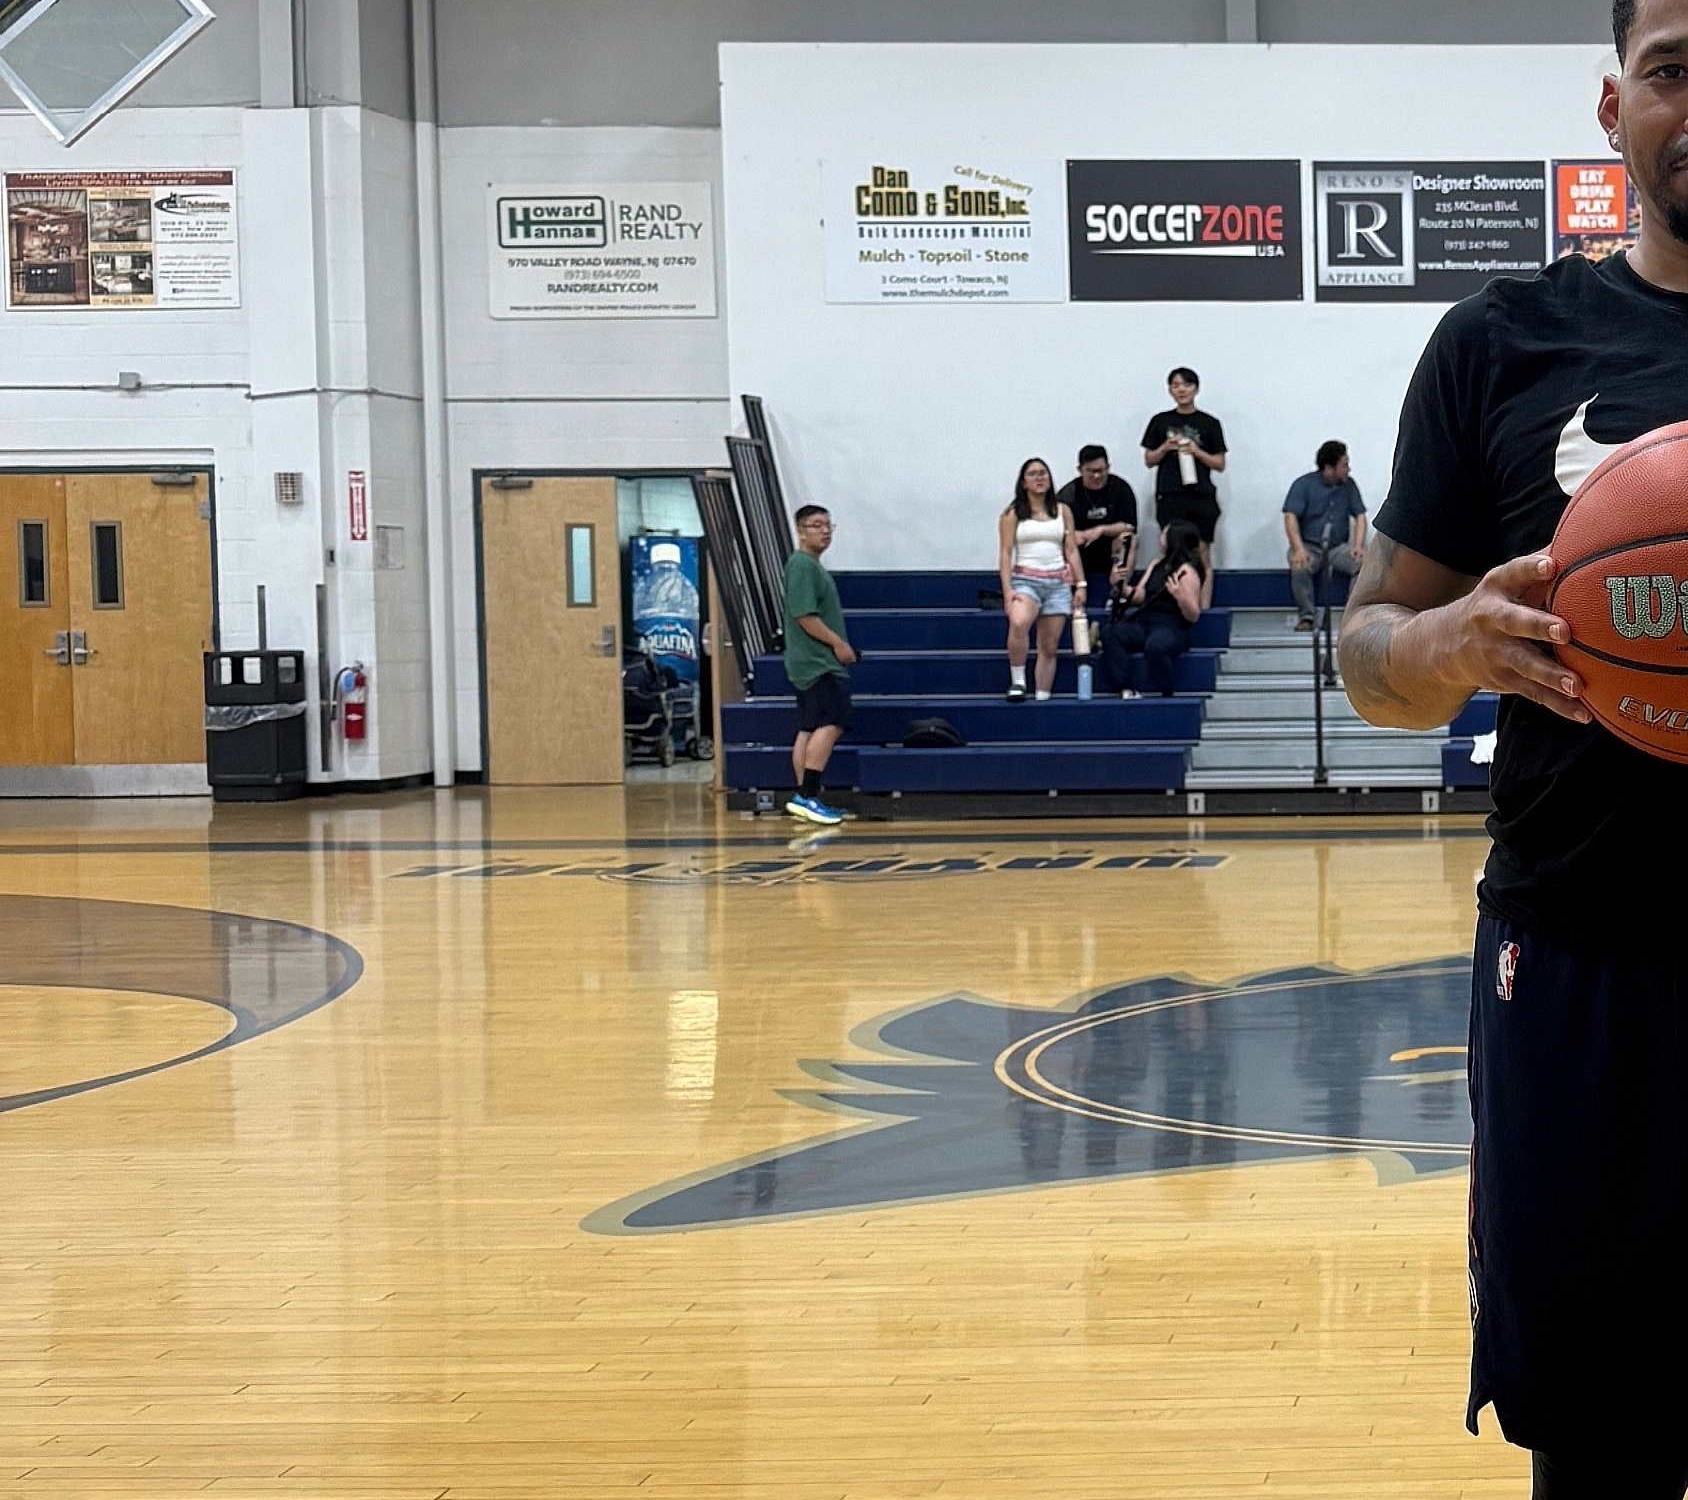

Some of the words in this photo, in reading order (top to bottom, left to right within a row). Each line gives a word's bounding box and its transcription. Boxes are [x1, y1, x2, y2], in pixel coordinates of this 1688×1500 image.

[873, 165, 908, 188] Dan
[954, 165, 973, 178] Call
[975, 170, 990, 182] for
[991, 175, 1034, 196] Delivery
[1412, 174, 1471, 194] Designer
[1473, 174, 1544, 190] Showroom
[1578, 169, 1607, 184] EAT
[1569, 184, 1615, 199] DRINK
[856, 185, 917, 216] Como
[925, 192, 937, 216] &
[944, 185, 1006, 218] Sons,
[1574, 199, 1612, 213] PLAY
[508, 203, 596, 222] Howard
[619, 205, 683, 221] RAND
[1336, 200, 1396, 258] R
[1419, 217, 1449, 229] Route
[1465, 217, 1475, 228] N
[1567, 214, 1619, 229] WATCH
[620, 223, 703, 240] REALTY
[859, 227, 888, 238] Bulk
[894, 227, 966, 239] Landscape
[971, 226, 1031, 238] Material
[859, 249, 905, 263] Mulch
[918, 249, 972, 265] Topsoil
[985, 249, 1029, 263] Stone
[1257, 246, 1285, 257] USA
[530, 258, 568, 267] VALLEY
[570, 257, 602, 267] ROAD
[889, 275, 917, 284] Como
[920, 275, 948, 284] Court
[1328, 273, 1404, 284] APPLIANCE
[547, 282, 659, 293] RANDREALTY.COM
